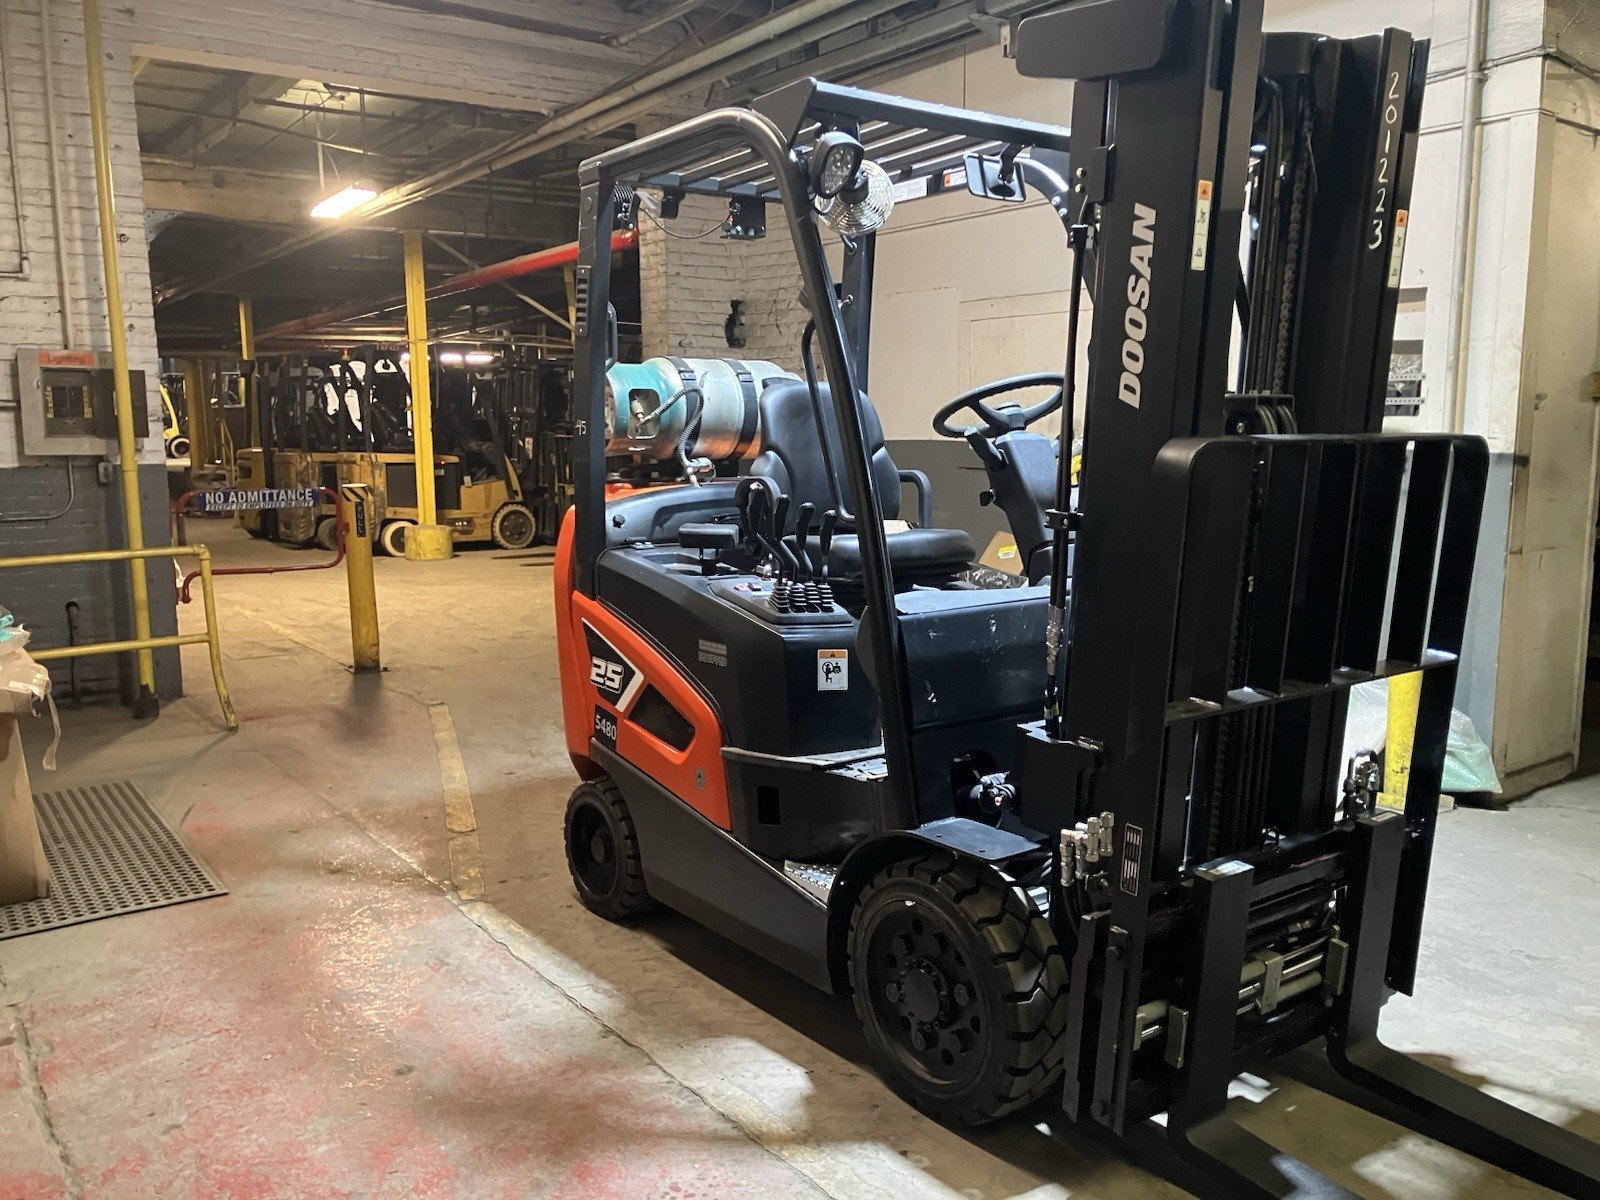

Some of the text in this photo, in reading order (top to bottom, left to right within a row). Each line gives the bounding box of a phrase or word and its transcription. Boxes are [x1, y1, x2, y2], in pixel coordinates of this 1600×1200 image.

[1368, 71, 1400, 249] 201223
[1118, 203, 1157, 409] DOOSAN
[47, 354, 85, 364] Lighting
[205, 488, 313, 504] NO ADMITTANCE
[590, 656, 624, 694] 25
[595, 714, 617, 740] 5480
